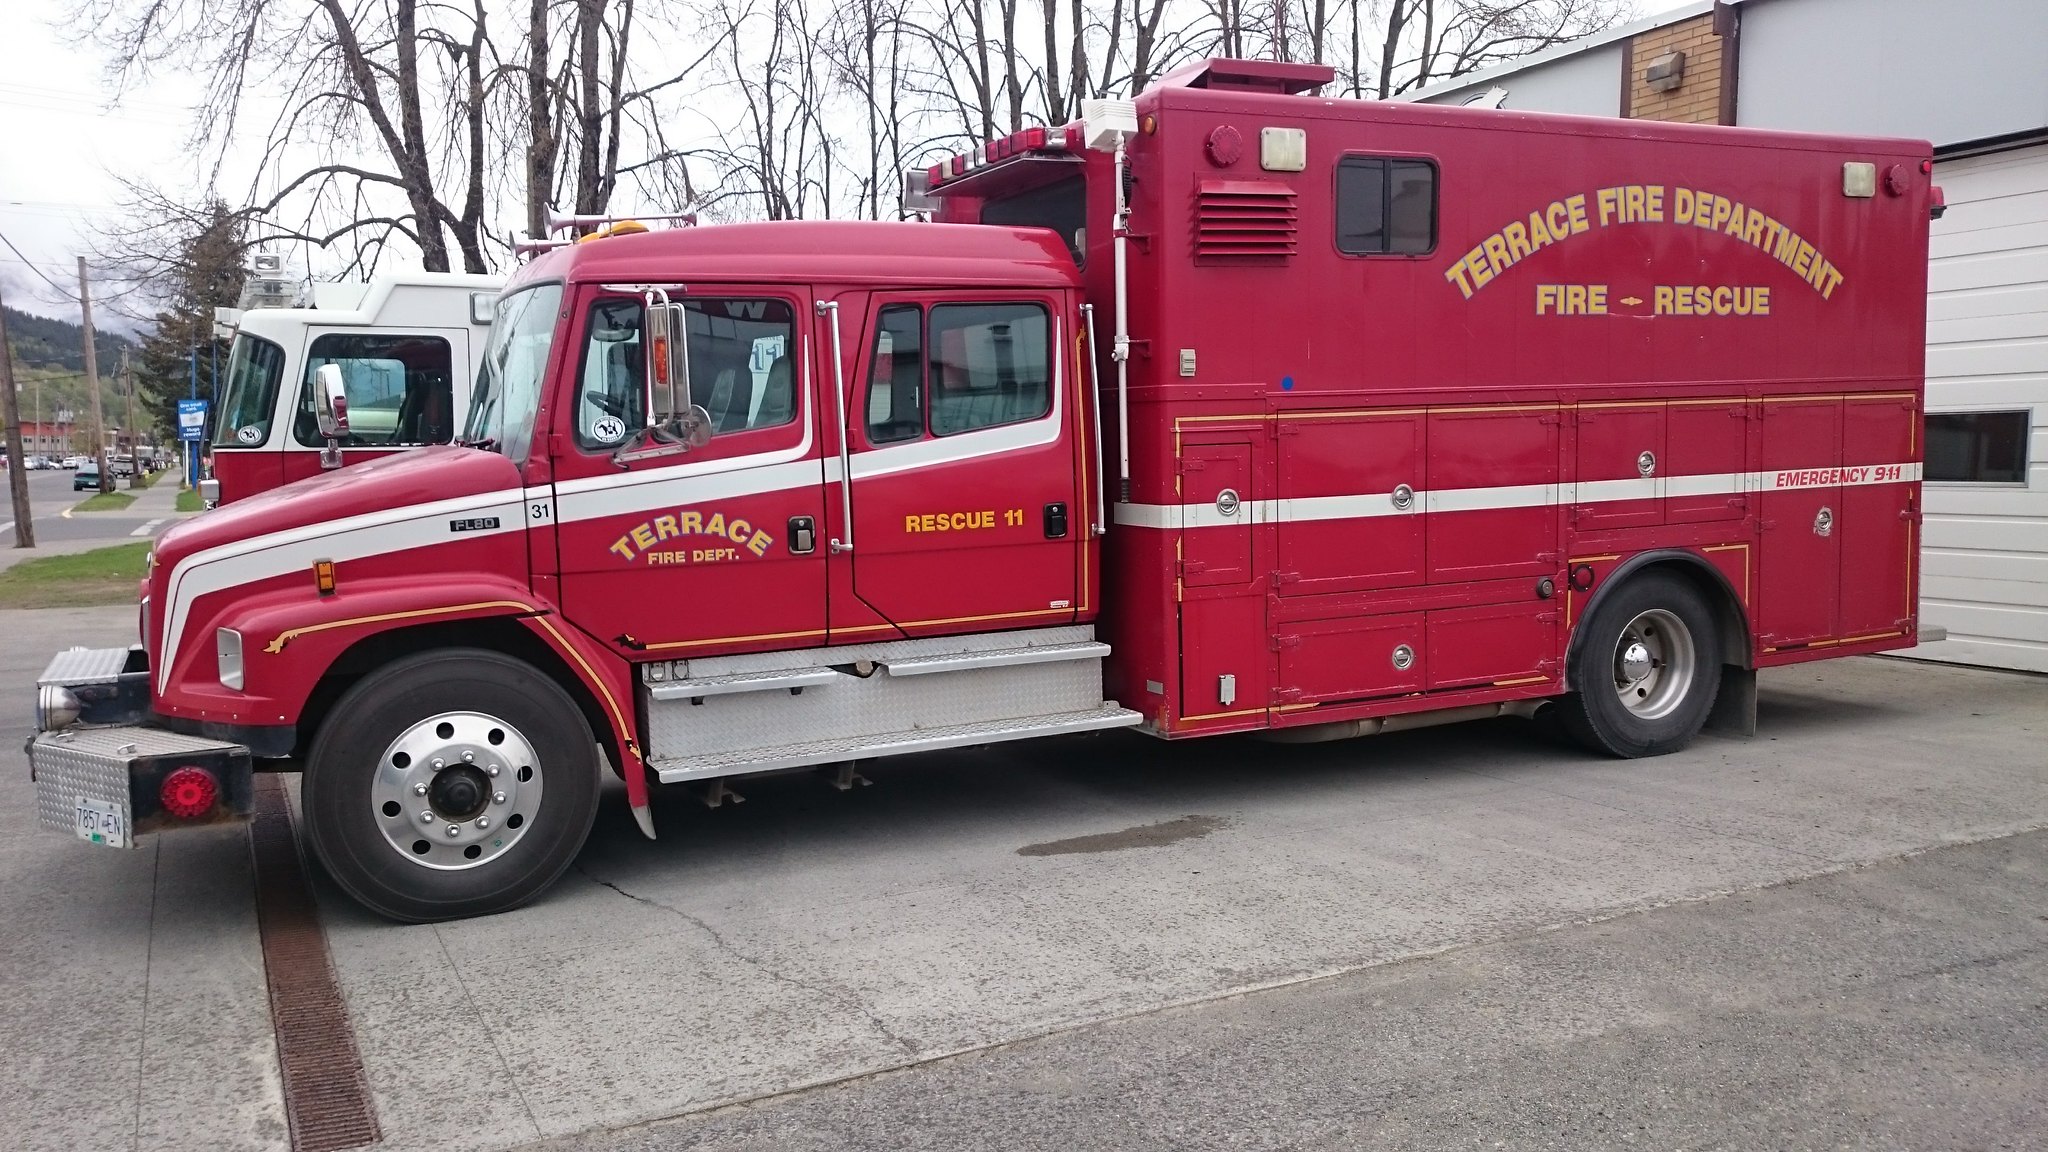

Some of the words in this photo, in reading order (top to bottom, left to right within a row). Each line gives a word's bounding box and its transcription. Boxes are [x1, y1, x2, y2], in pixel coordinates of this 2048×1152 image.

[1444, 194, 1590, 300] TERRACE
[1596, 185, 1665, 227] FIRE
[1674, 187, 1844, 300] DEPARTMENT
[1536, 284, 1608, 315] FIRE
[1655, 286, 1770, 315] RESCUE
[1776, 467, 1869, 487] EMERGENCY
[531, 504, 549, 519] 31
[905, 511, 996, 533] RESCUE
[1004, 509, 1024, 526] 11
[455, 518, 495, 531] FL80
[609, 510, 774, 562] TERRACE
[647, 551, 686, 565] FIRE
[693, 548, 740, 562] DEPT.
[77, 808, 100, 831] 7857
